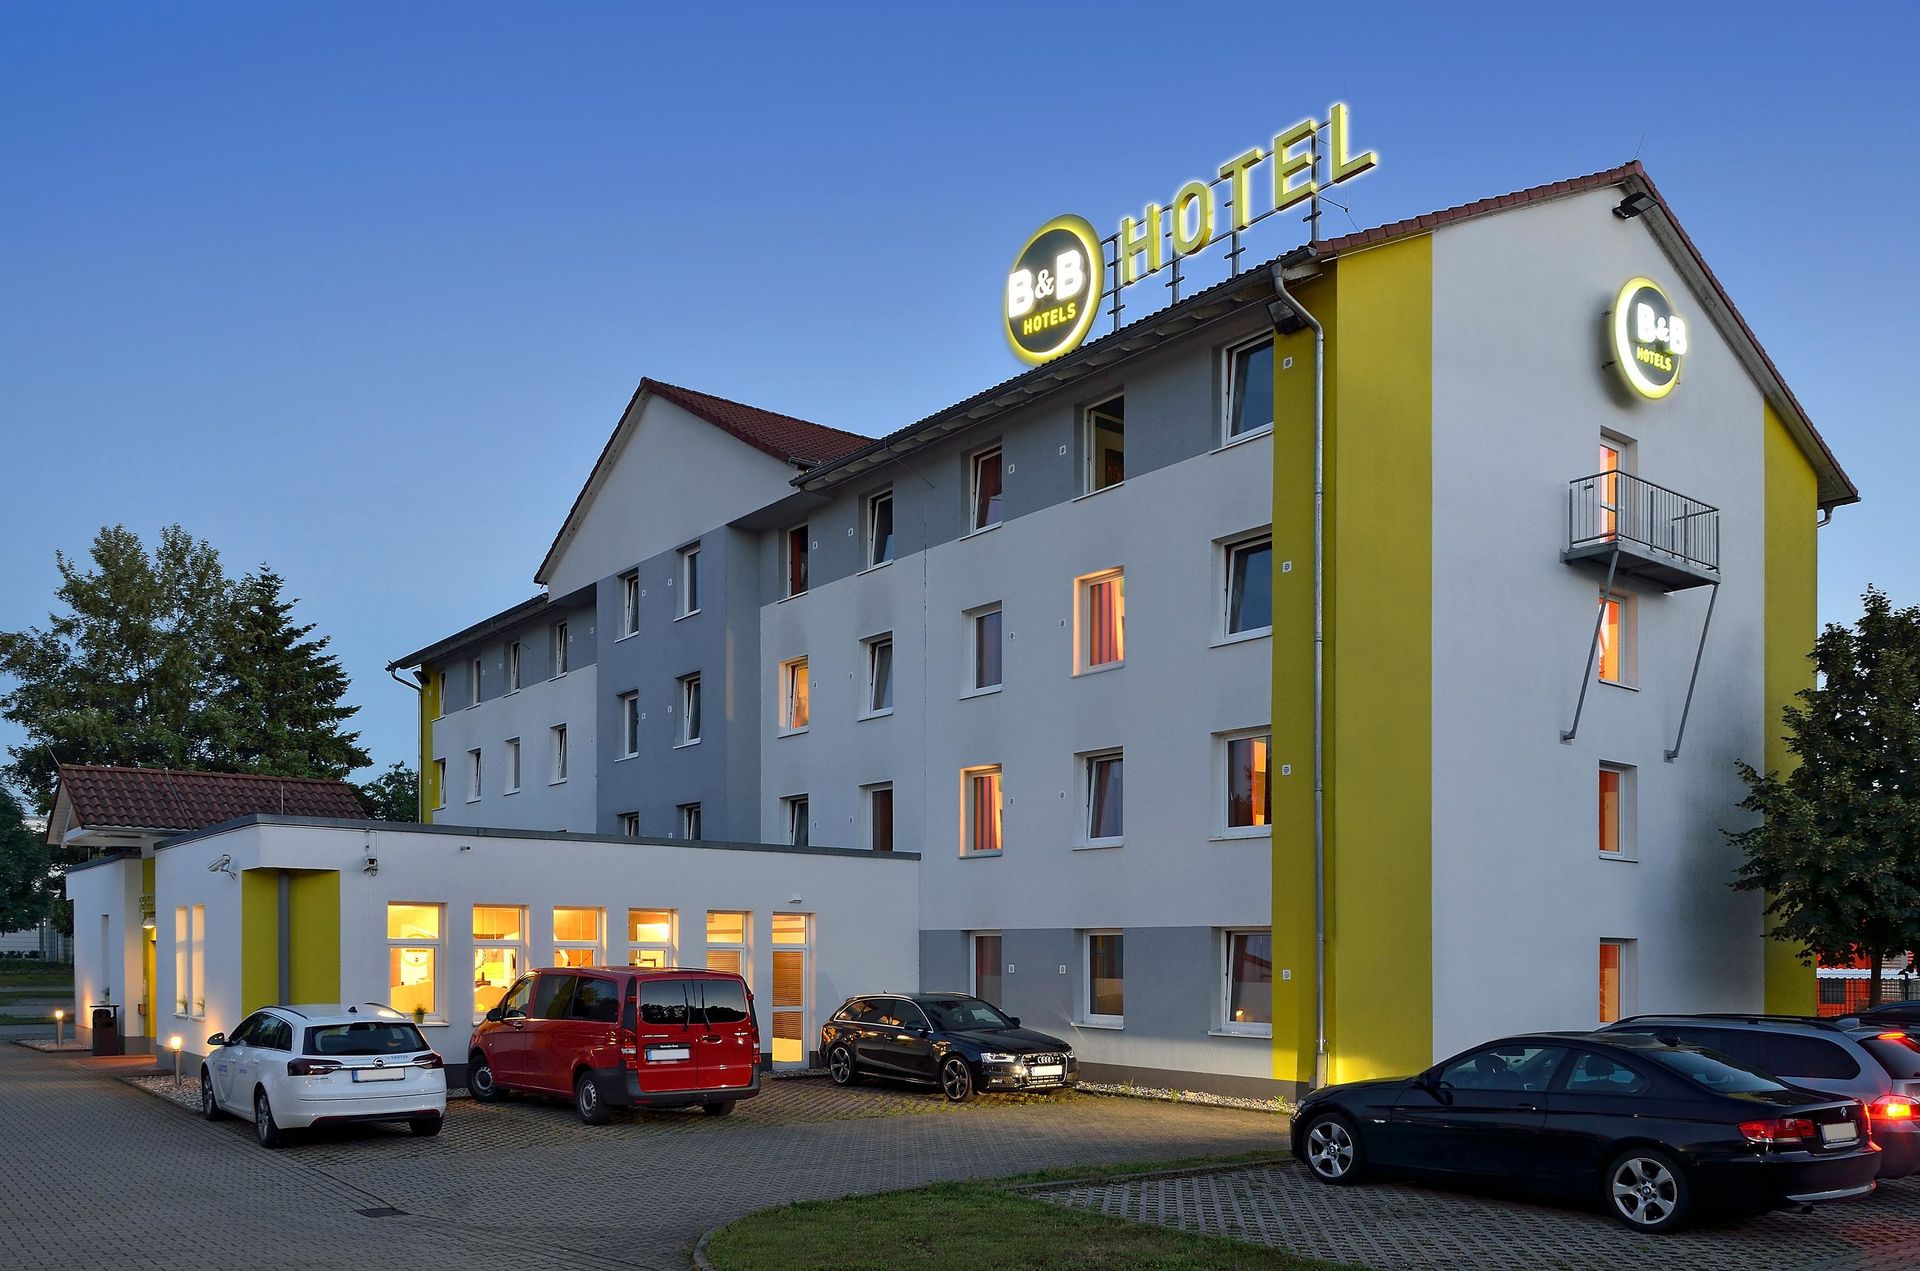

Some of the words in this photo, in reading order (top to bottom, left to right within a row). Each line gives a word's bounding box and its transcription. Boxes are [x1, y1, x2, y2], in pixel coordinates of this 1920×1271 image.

[1121, 104, 1376, 285] HOTEL
[1009, 249, 1084, 318] B&B
[1023, 302, 1076, 335] HOTELS
[1637, 302, 1687, 355] B&B
[1637, 347, 1672, 371] HOTELS
